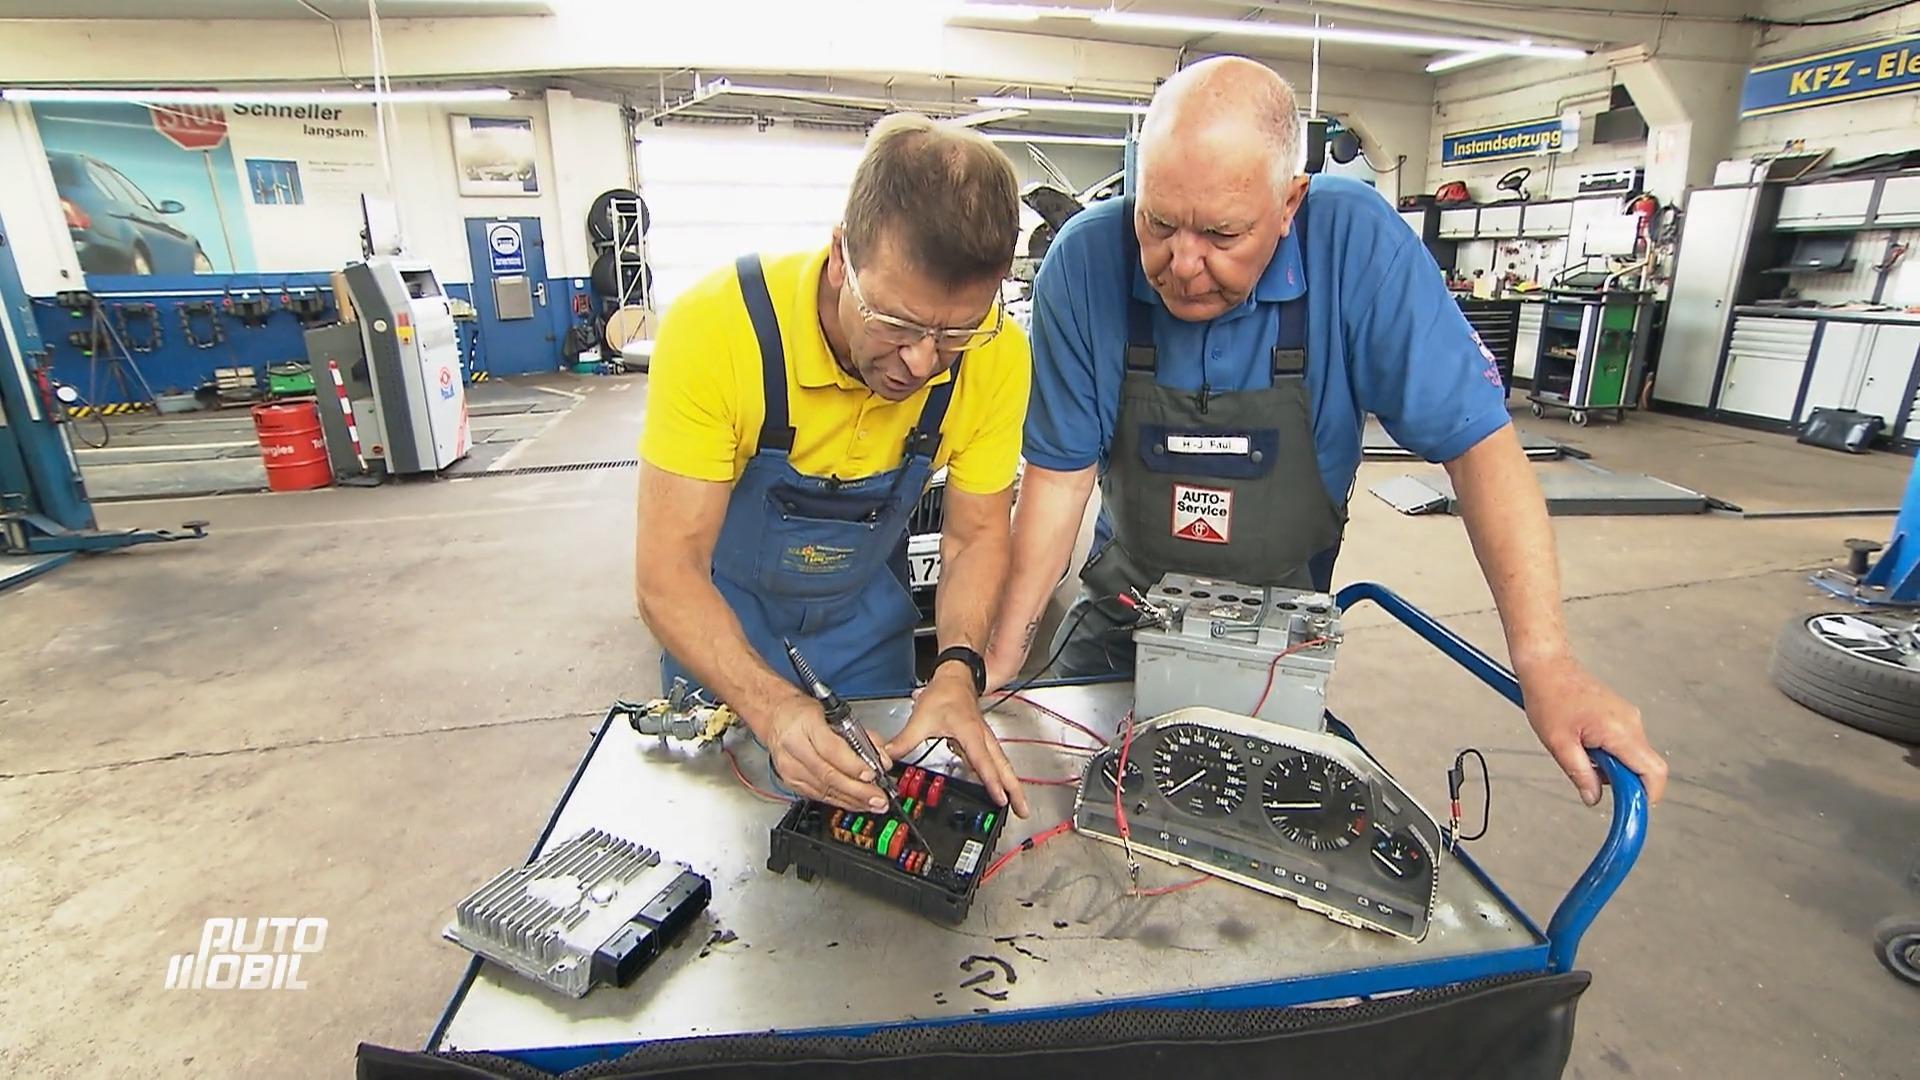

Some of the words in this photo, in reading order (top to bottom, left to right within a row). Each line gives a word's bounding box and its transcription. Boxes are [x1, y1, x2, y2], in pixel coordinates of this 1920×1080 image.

[1788, 60, 1856, 96] KFZ
[233, 102, 343, 122] Schneller
[302, 123, 369, 139] langsam.
[1453, 129, 1562, 157] Instandsetzung
[1182, 490, 1225, 506] AUTO-
[1177, 500, 1228, 517] Service
